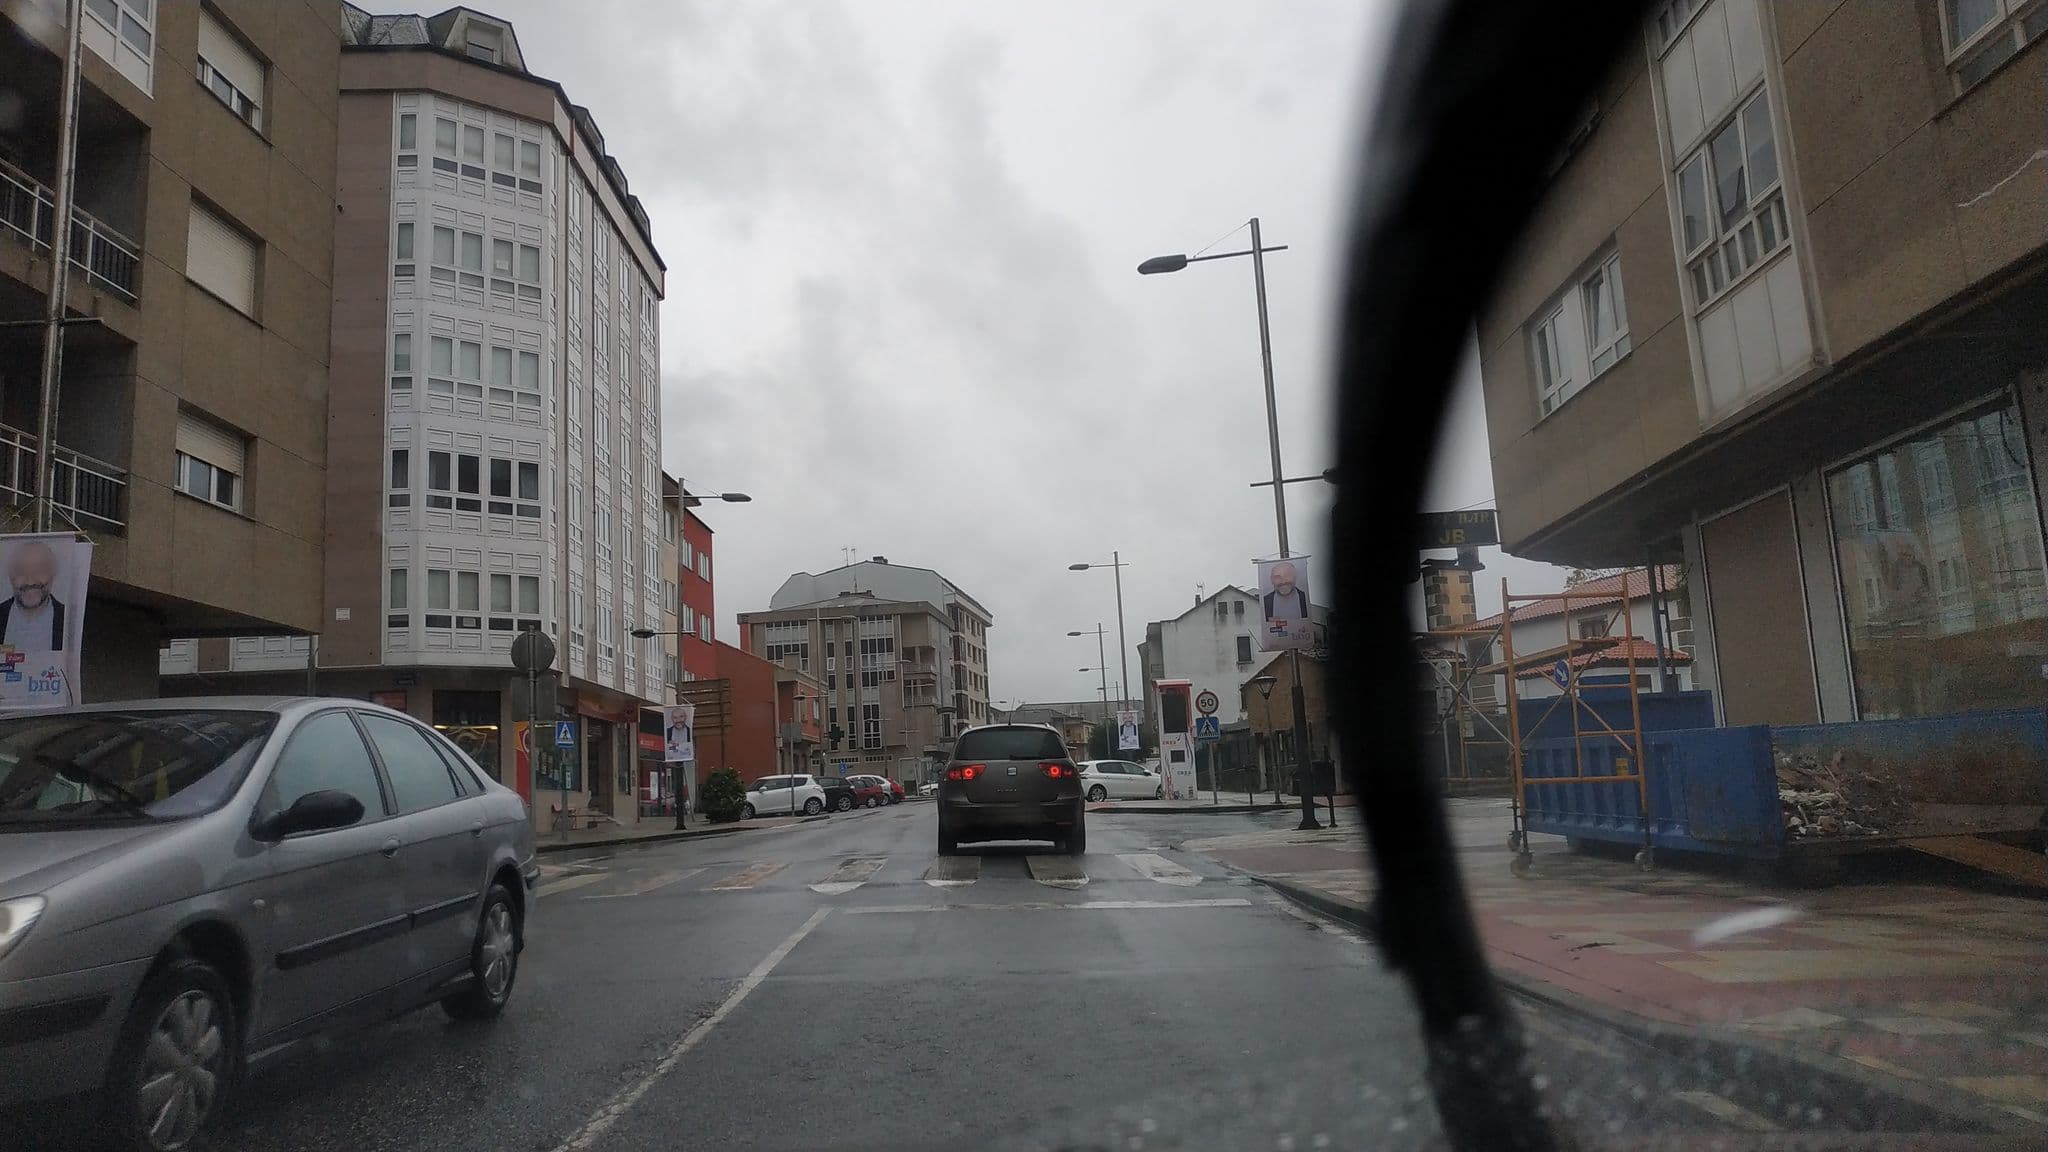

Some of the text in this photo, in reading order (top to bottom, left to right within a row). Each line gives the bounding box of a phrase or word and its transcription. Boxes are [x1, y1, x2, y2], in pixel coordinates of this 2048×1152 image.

[1439, 528, 1466, 545] JB
[29, 676, 61, 695] bng
[1200, 698, 1214, 708] 50
